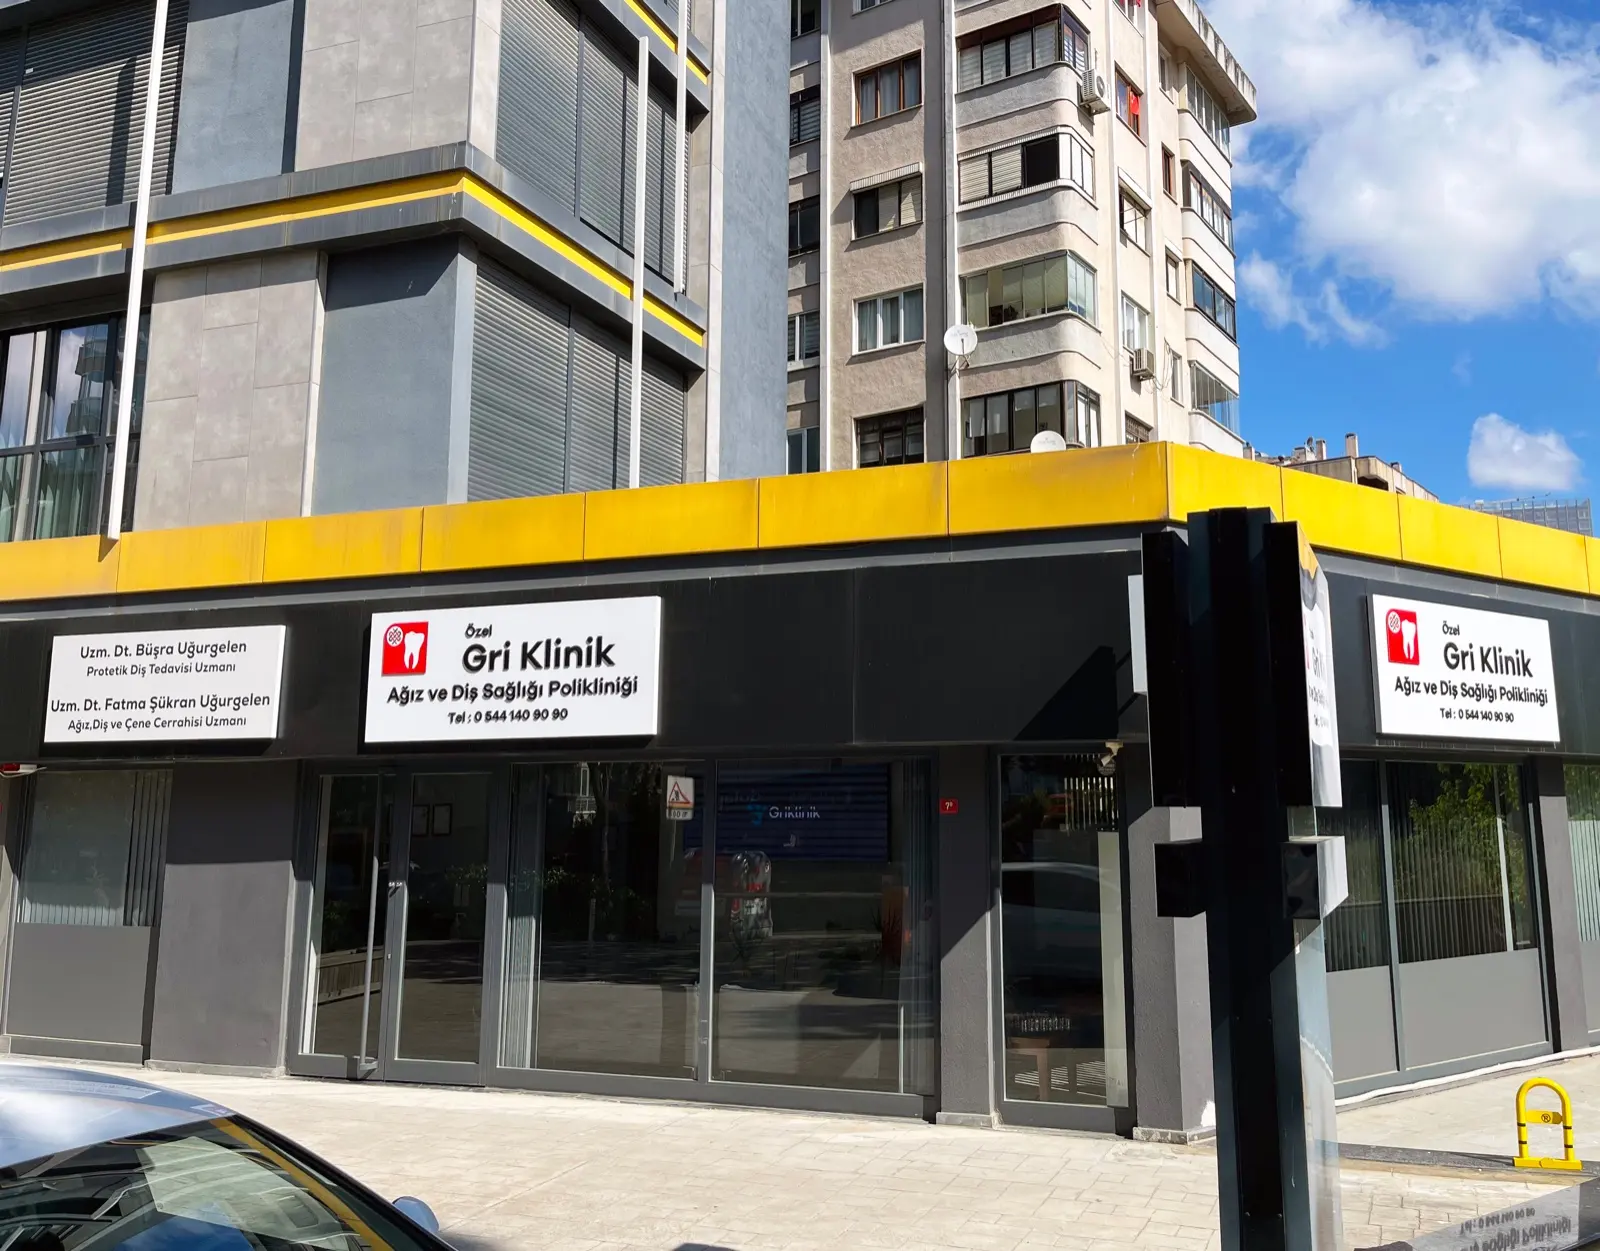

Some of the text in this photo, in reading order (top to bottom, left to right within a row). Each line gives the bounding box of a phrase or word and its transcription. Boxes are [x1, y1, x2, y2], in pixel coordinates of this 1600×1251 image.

[465, 623, 492, 639] Özel
[1442, 621, 1460, 636] Özel
[80, 640, 247, 659] Uzm. Dt. Büşra Uğurgelen
[462, 636, 615, 674] Gri Klinik
[1443, 642, 1533, 678] Gri Klinik
[87, 662, 235, 678] Protetik Diş Tedavisi Uzmanı
[387, 676, 638, 706] Ağız ve Diş Sağlığı Polikliniği
[1395, 676, 1548, 707] Ağız ve Diş Sağlığı Polikliniği
[51, 693, 270, 713] Uzm. Dt. Fatma Şükran Uğurgelen
[448, 711, 466, 724] Tel
[474, 711, 482, 723] 0
[484, 710, 507, 723] 544
[509, 709, 530, 722] 140
[533, 708, 549, 721] 90
[552, 708, 568, 721] 90
[1440, 708, 1452, 719] Tel
[1458, 709, 1464, 719] 0
[1465, 709, 1479, 720] 544
[1480, 711, 1493, 721] 140
[1494, 711, 1503, 722] 90
[1505, 712, 1514, 723] 90
[68, 716, 246, 734] Ağız,Diş ve Çene Cerrahisi Uzmanı
